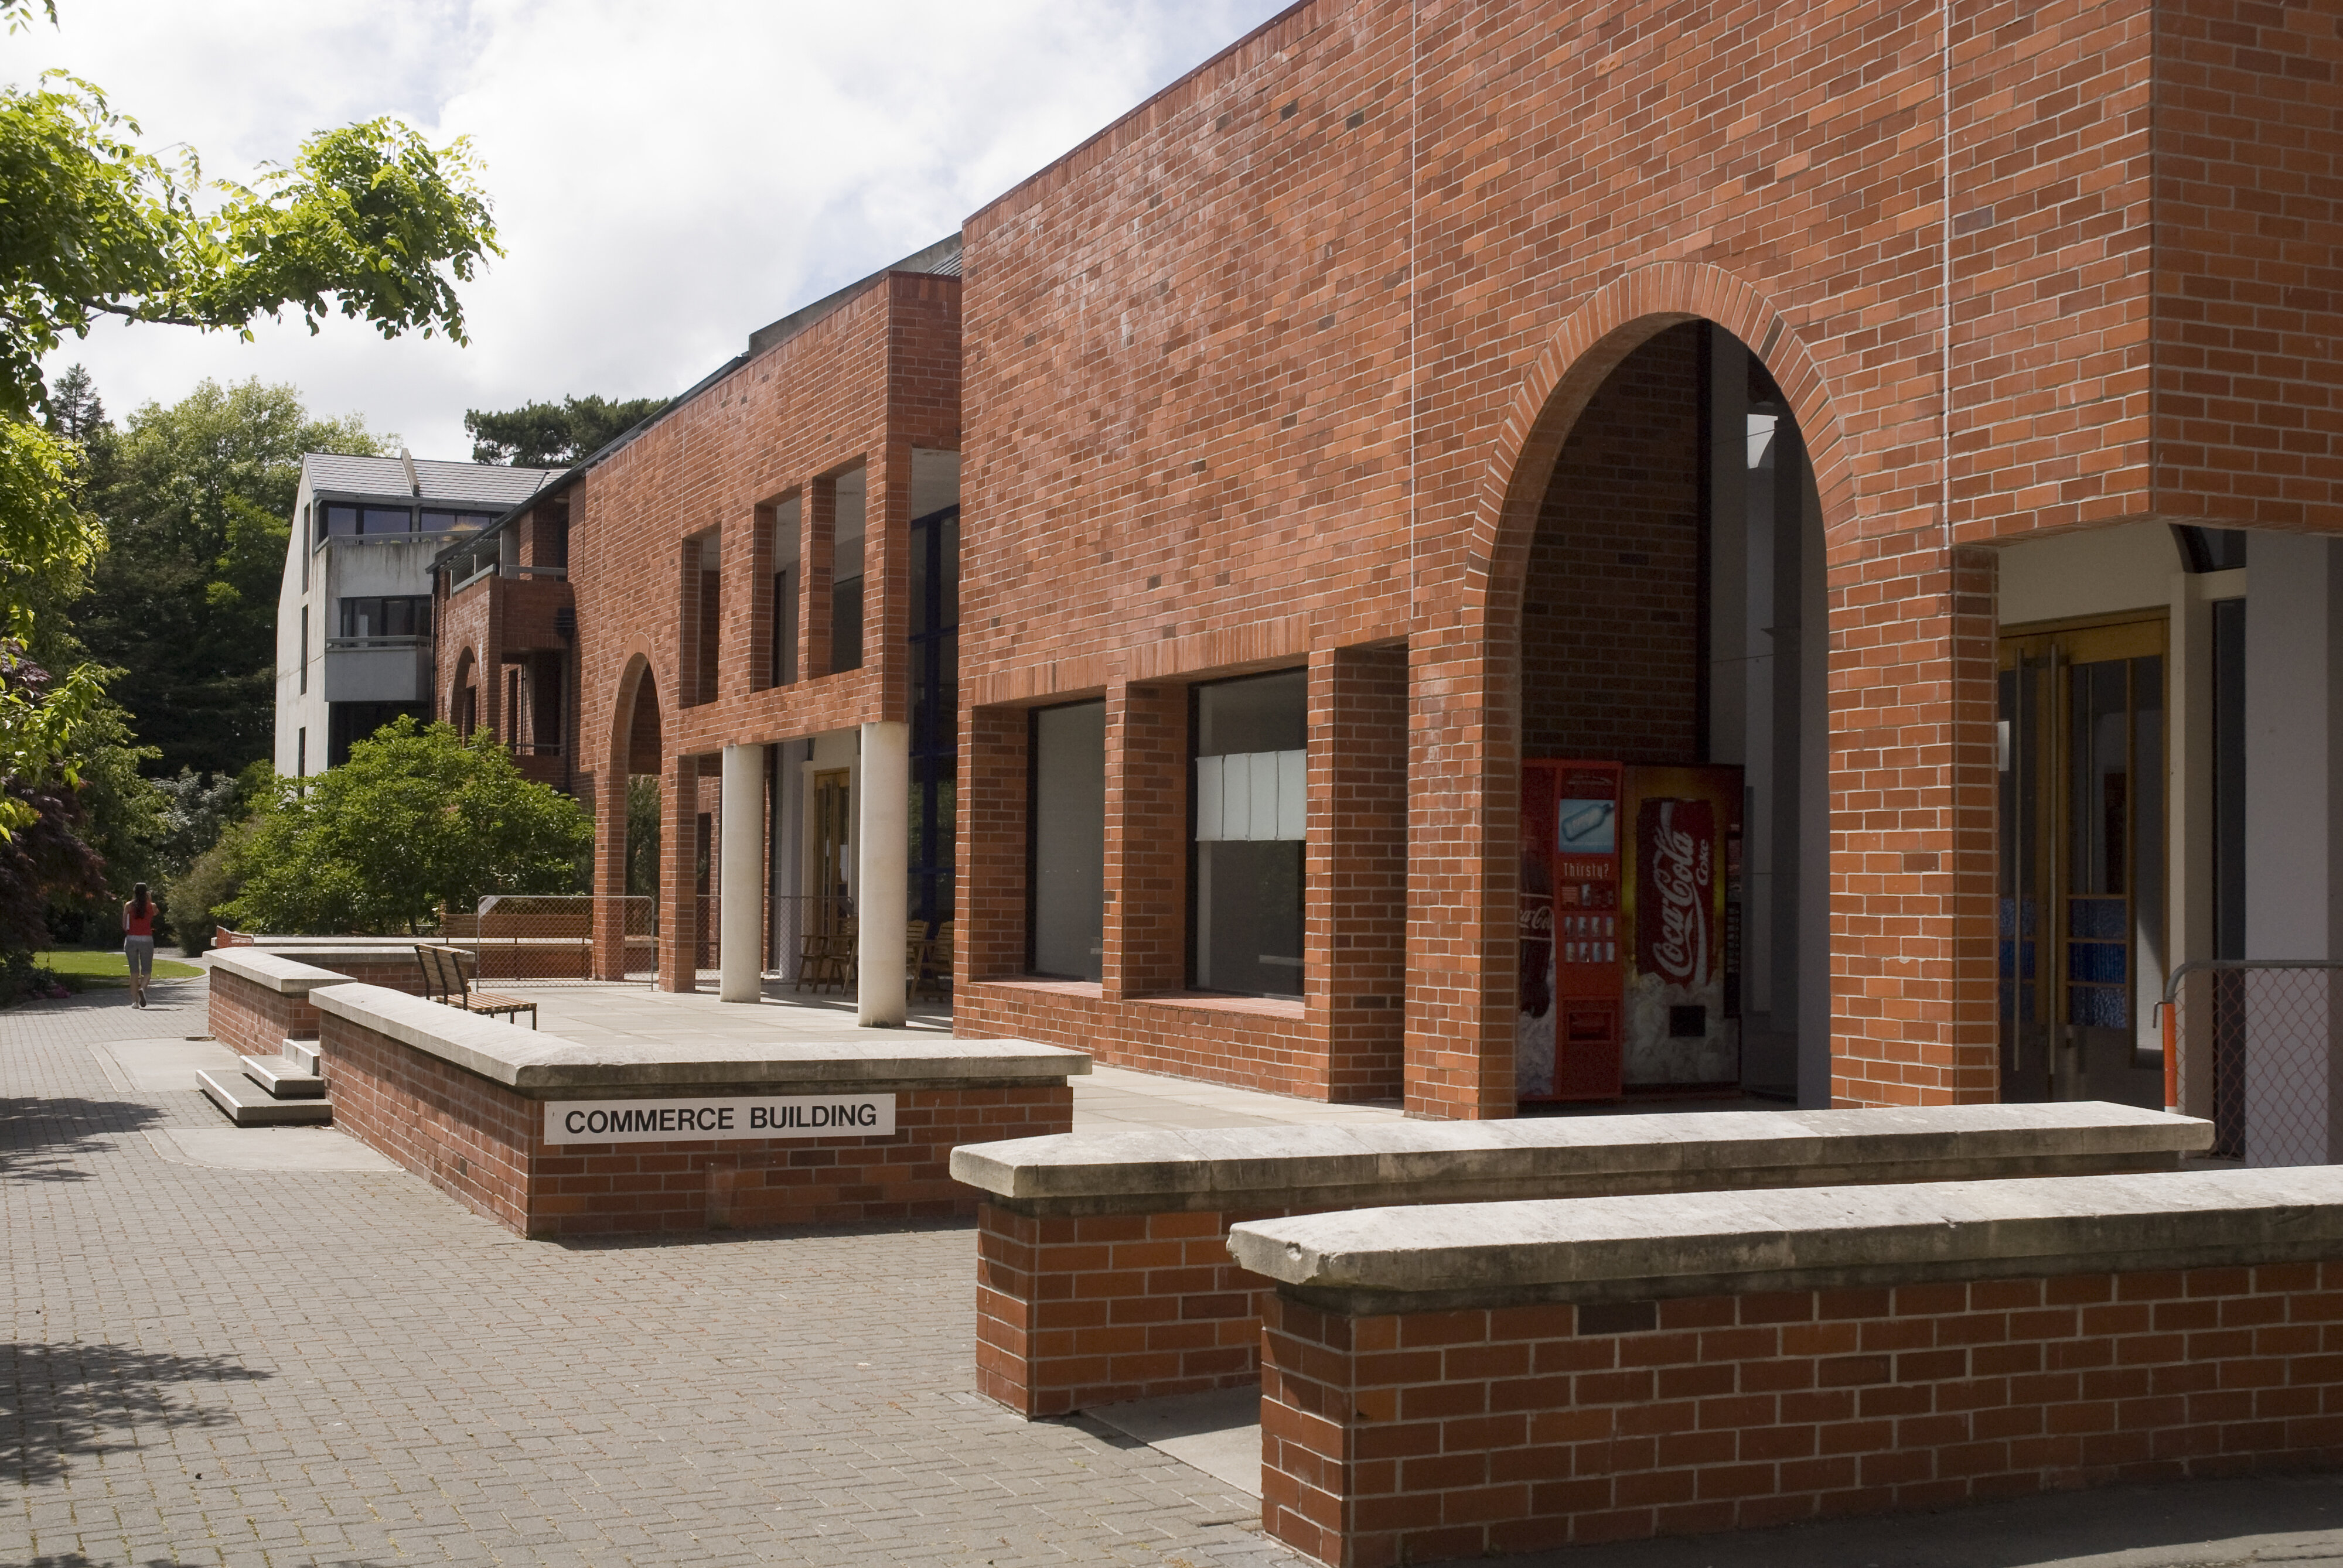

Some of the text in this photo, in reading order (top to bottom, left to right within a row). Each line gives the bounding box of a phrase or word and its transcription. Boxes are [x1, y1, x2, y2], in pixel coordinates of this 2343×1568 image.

[1563, 862, 1609, 879] Thirsty?
[1696, 839, 1709, 886] Coke
[565, 1104, 877, 1134] COMMERCE BUILDING
